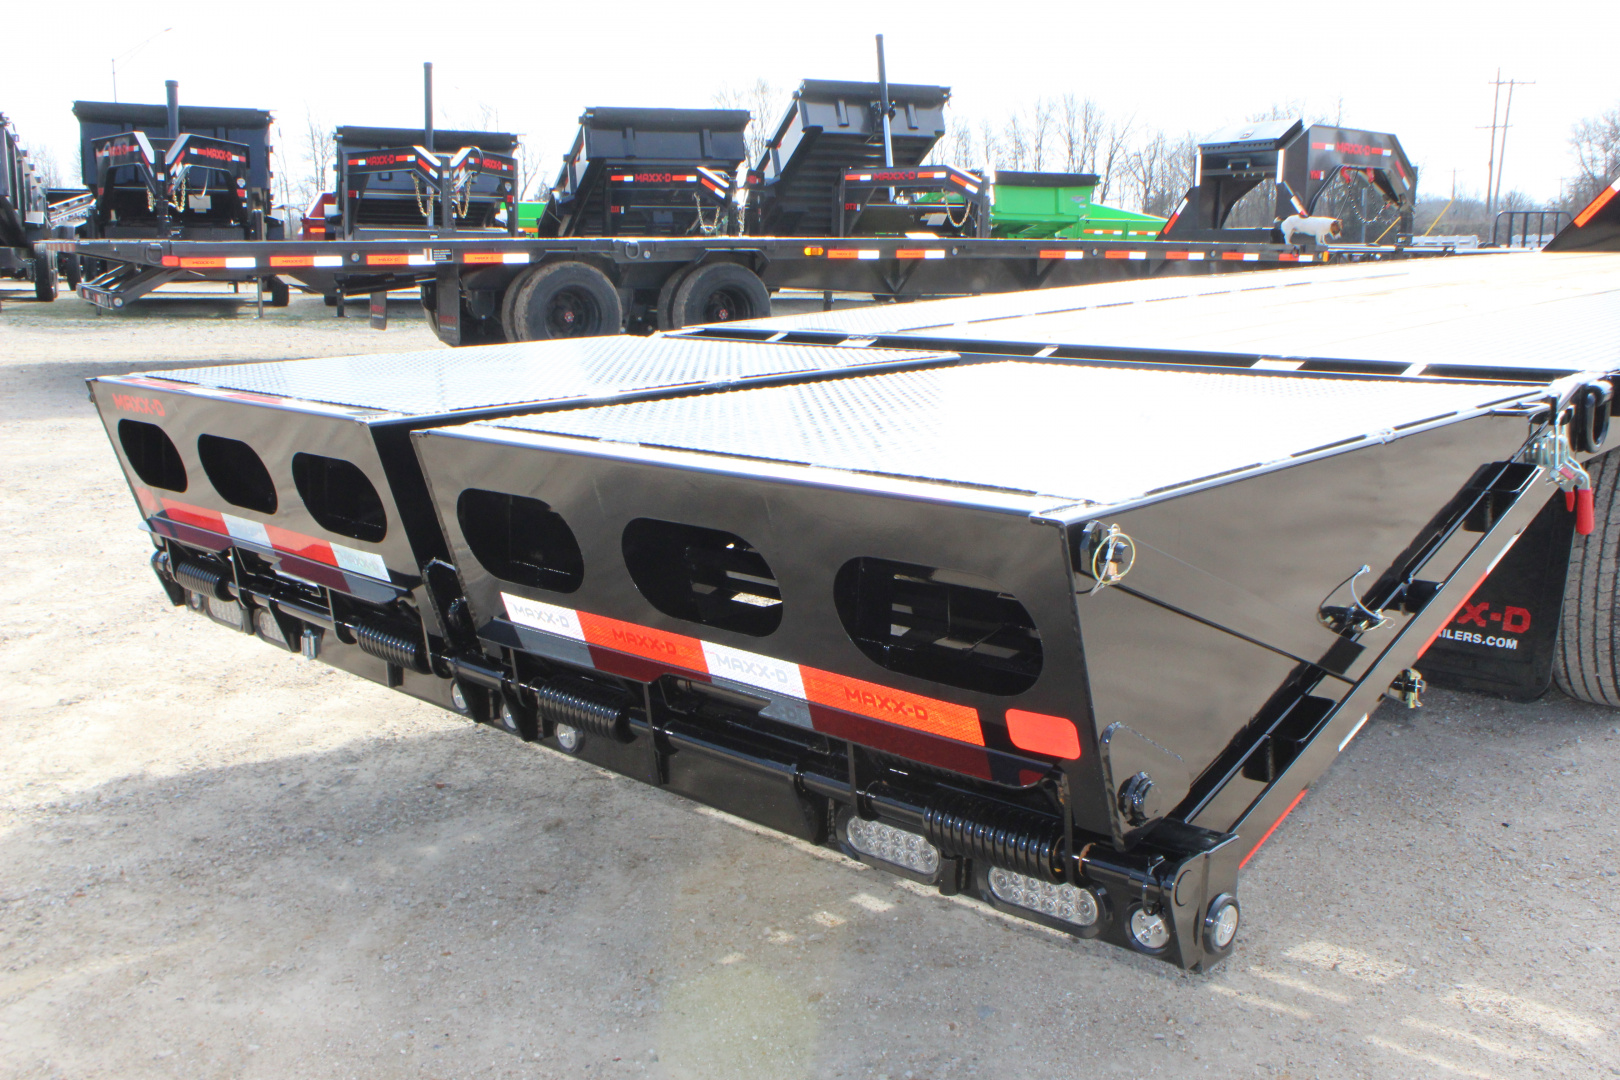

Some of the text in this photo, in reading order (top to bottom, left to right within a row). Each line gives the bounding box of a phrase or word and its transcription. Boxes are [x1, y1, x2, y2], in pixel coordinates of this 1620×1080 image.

[206, 147, 232, 161] MAXX-D
[1335, 141, 1372, 156] MAXX-D
[366, 153, 395, 167] MAXX-D
[482, 157, 502, 171] MAXX-D
[635, 173, 672, 182] MAXX-D
[873, 171, 916, 181] MAXX-D
[112, 393, 166, 417] MAXX-D
[512, 602, 571, 629] MAXX-D
[1455, 601, 1531, 634] X-D
[611, 627, 677, 656] MAXX-D
[713, 651, 789, 685] MAXX-D
[843, 686, 929, 720] MAXX-D
